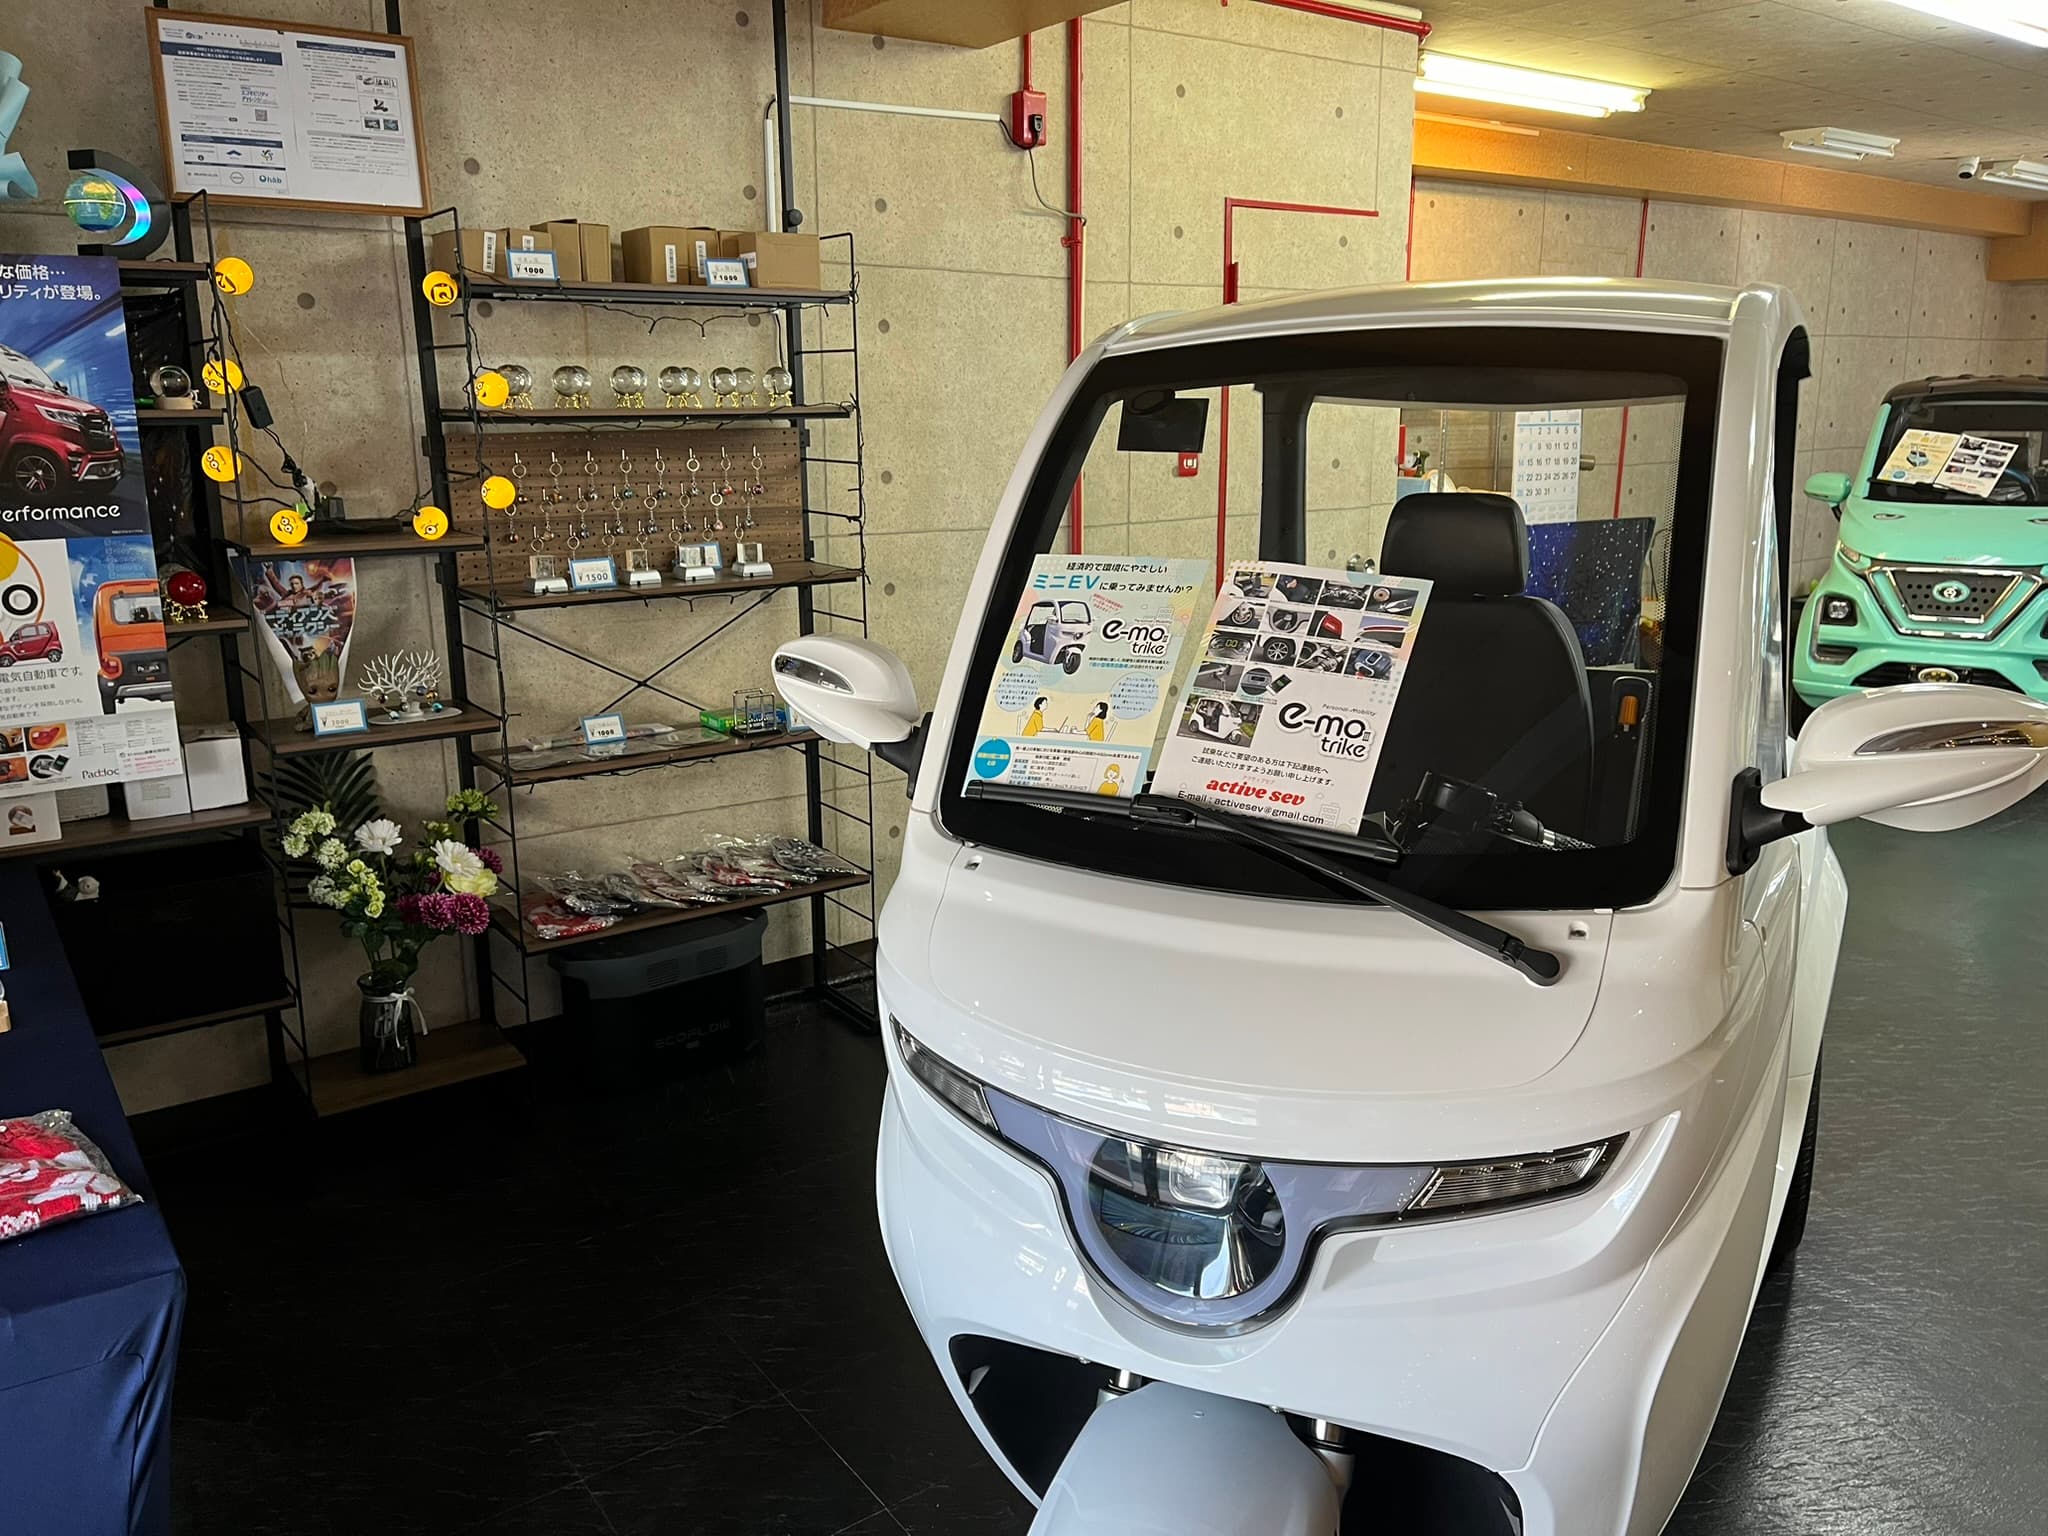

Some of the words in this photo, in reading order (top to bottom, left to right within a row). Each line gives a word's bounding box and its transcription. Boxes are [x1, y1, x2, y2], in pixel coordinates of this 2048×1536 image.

[1538, 427, 1542, 435] 2
[1535, 488, 1542, 496] 30
[0, 505, 120, 522] erformance
[1066, 562, 1168, 574] 経済的で環境にやさしい
[586, 572, 608, 581] 1500
[261, 604, 338, 624] ーディアンズ
[1132, 641, 1165, 654] trike
[1278, 702, 1366, 739] e-mo
[1321, 736, 1366, 757] trike
[82, 768, 119, 779] Paddoc
[1206, 779, 1268, 799] active
[1268, 789, 1306, 806] sev
[1177, 790, 1207, 803] E-mail
[1214, 798, 1324, 825] activesev@gmail.com
